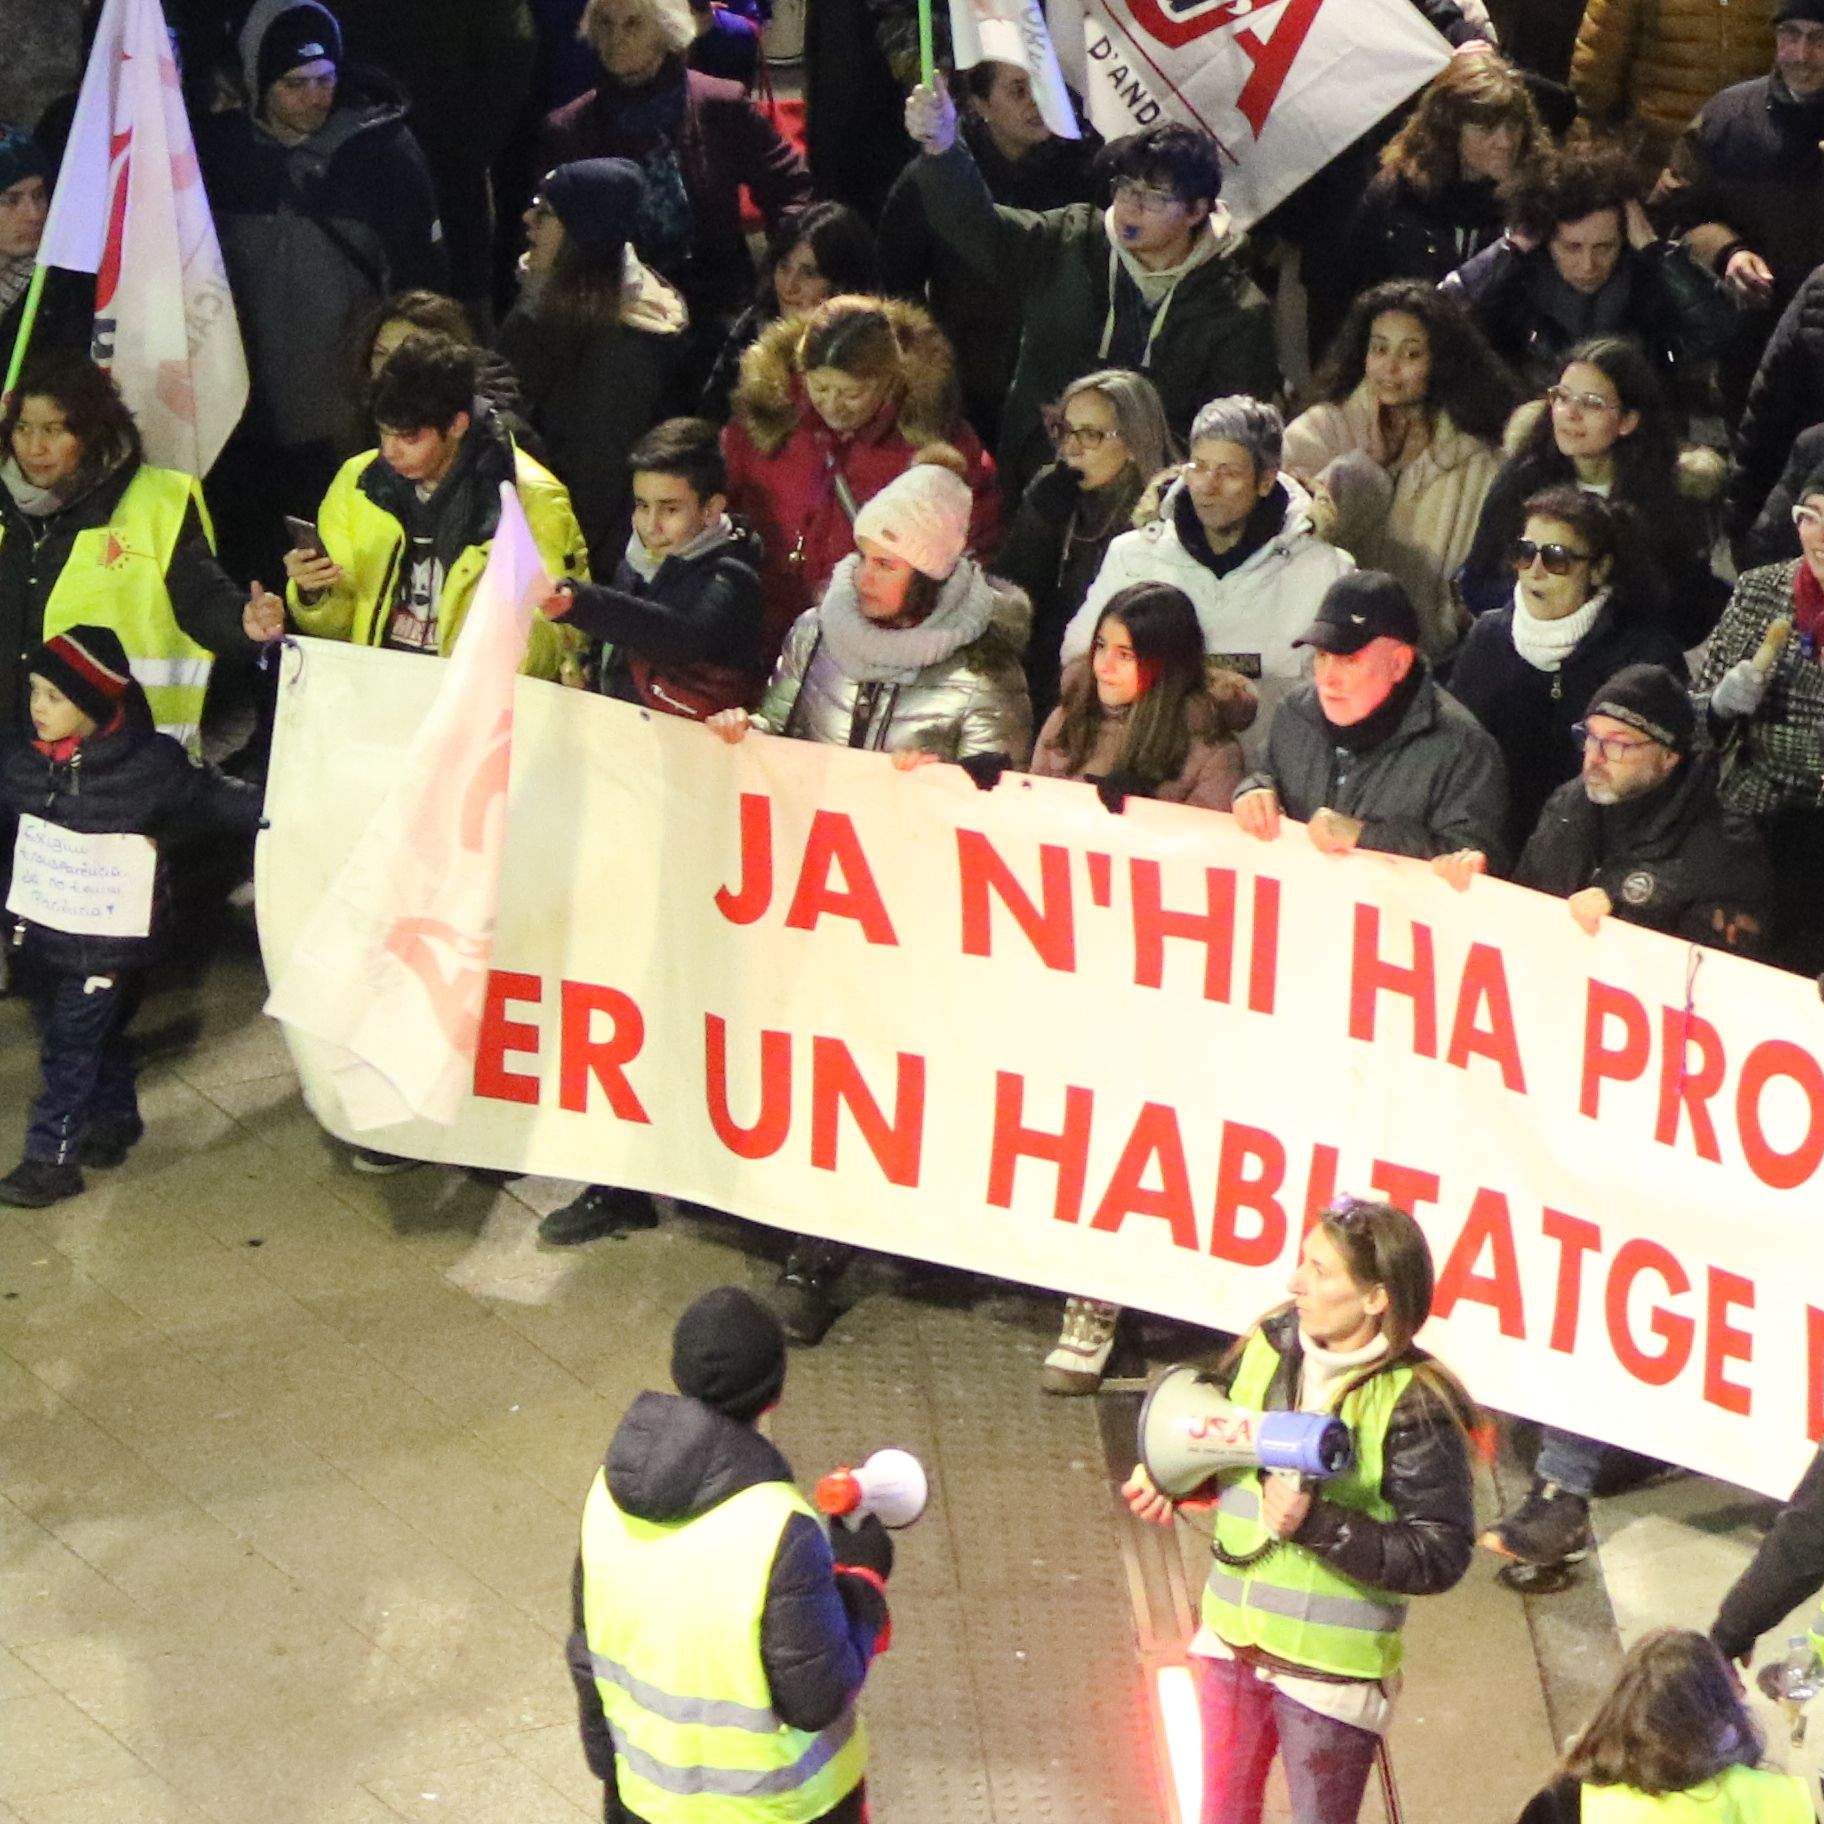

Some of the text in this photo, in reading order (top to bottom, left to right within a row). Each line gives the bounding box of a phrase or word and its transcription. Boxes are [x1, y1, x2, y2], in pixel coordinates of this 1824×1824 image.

[715, 792, 898, 947] JA
[956, 828, 1281, 1014] N'HI
[1348, 903, 1526, 1095] HA
[473, 971, 653, 1125] ER
[705, 1012, 927, 1188] UN
